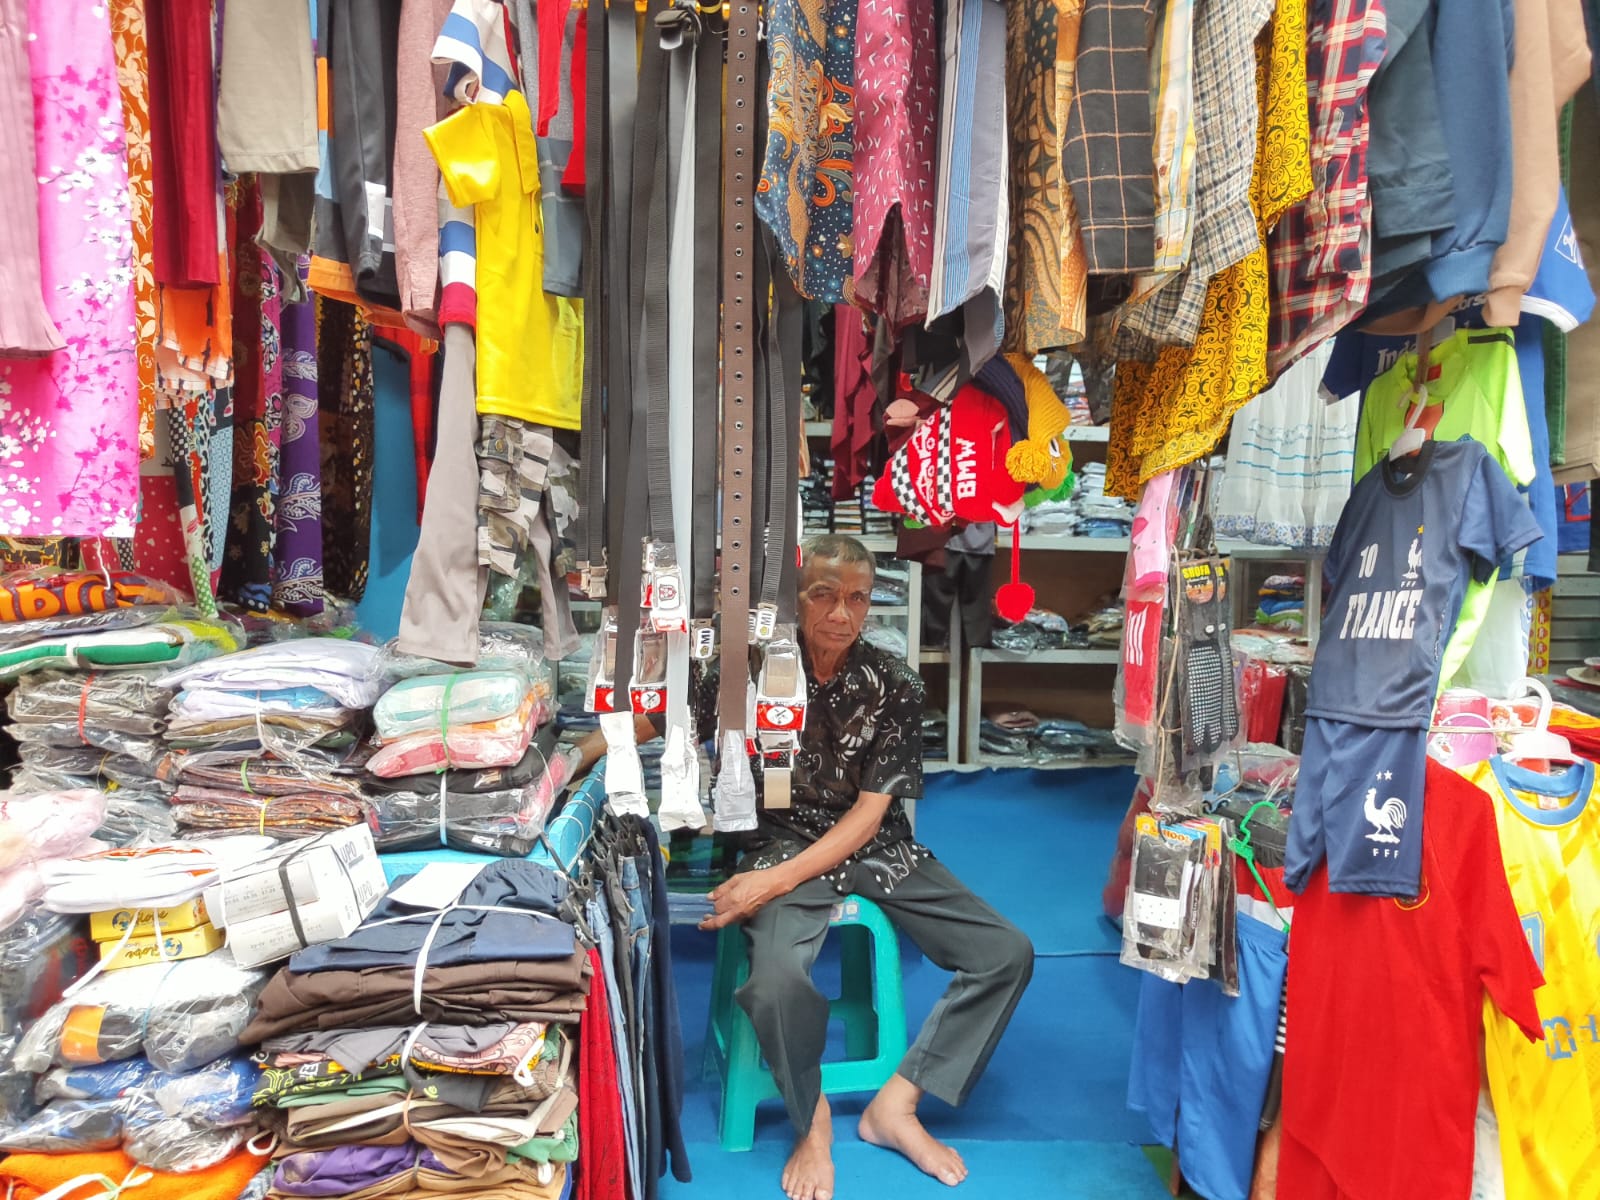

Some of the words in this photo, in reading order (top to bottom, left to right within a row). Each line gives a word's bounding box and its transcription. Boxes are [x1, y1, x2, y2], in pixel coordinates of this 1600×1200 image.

[956, 437, 976, 500] BMW
[1358, 543, 1379, 578] 10
[1340, 589, 1424, 639] FRANCE
